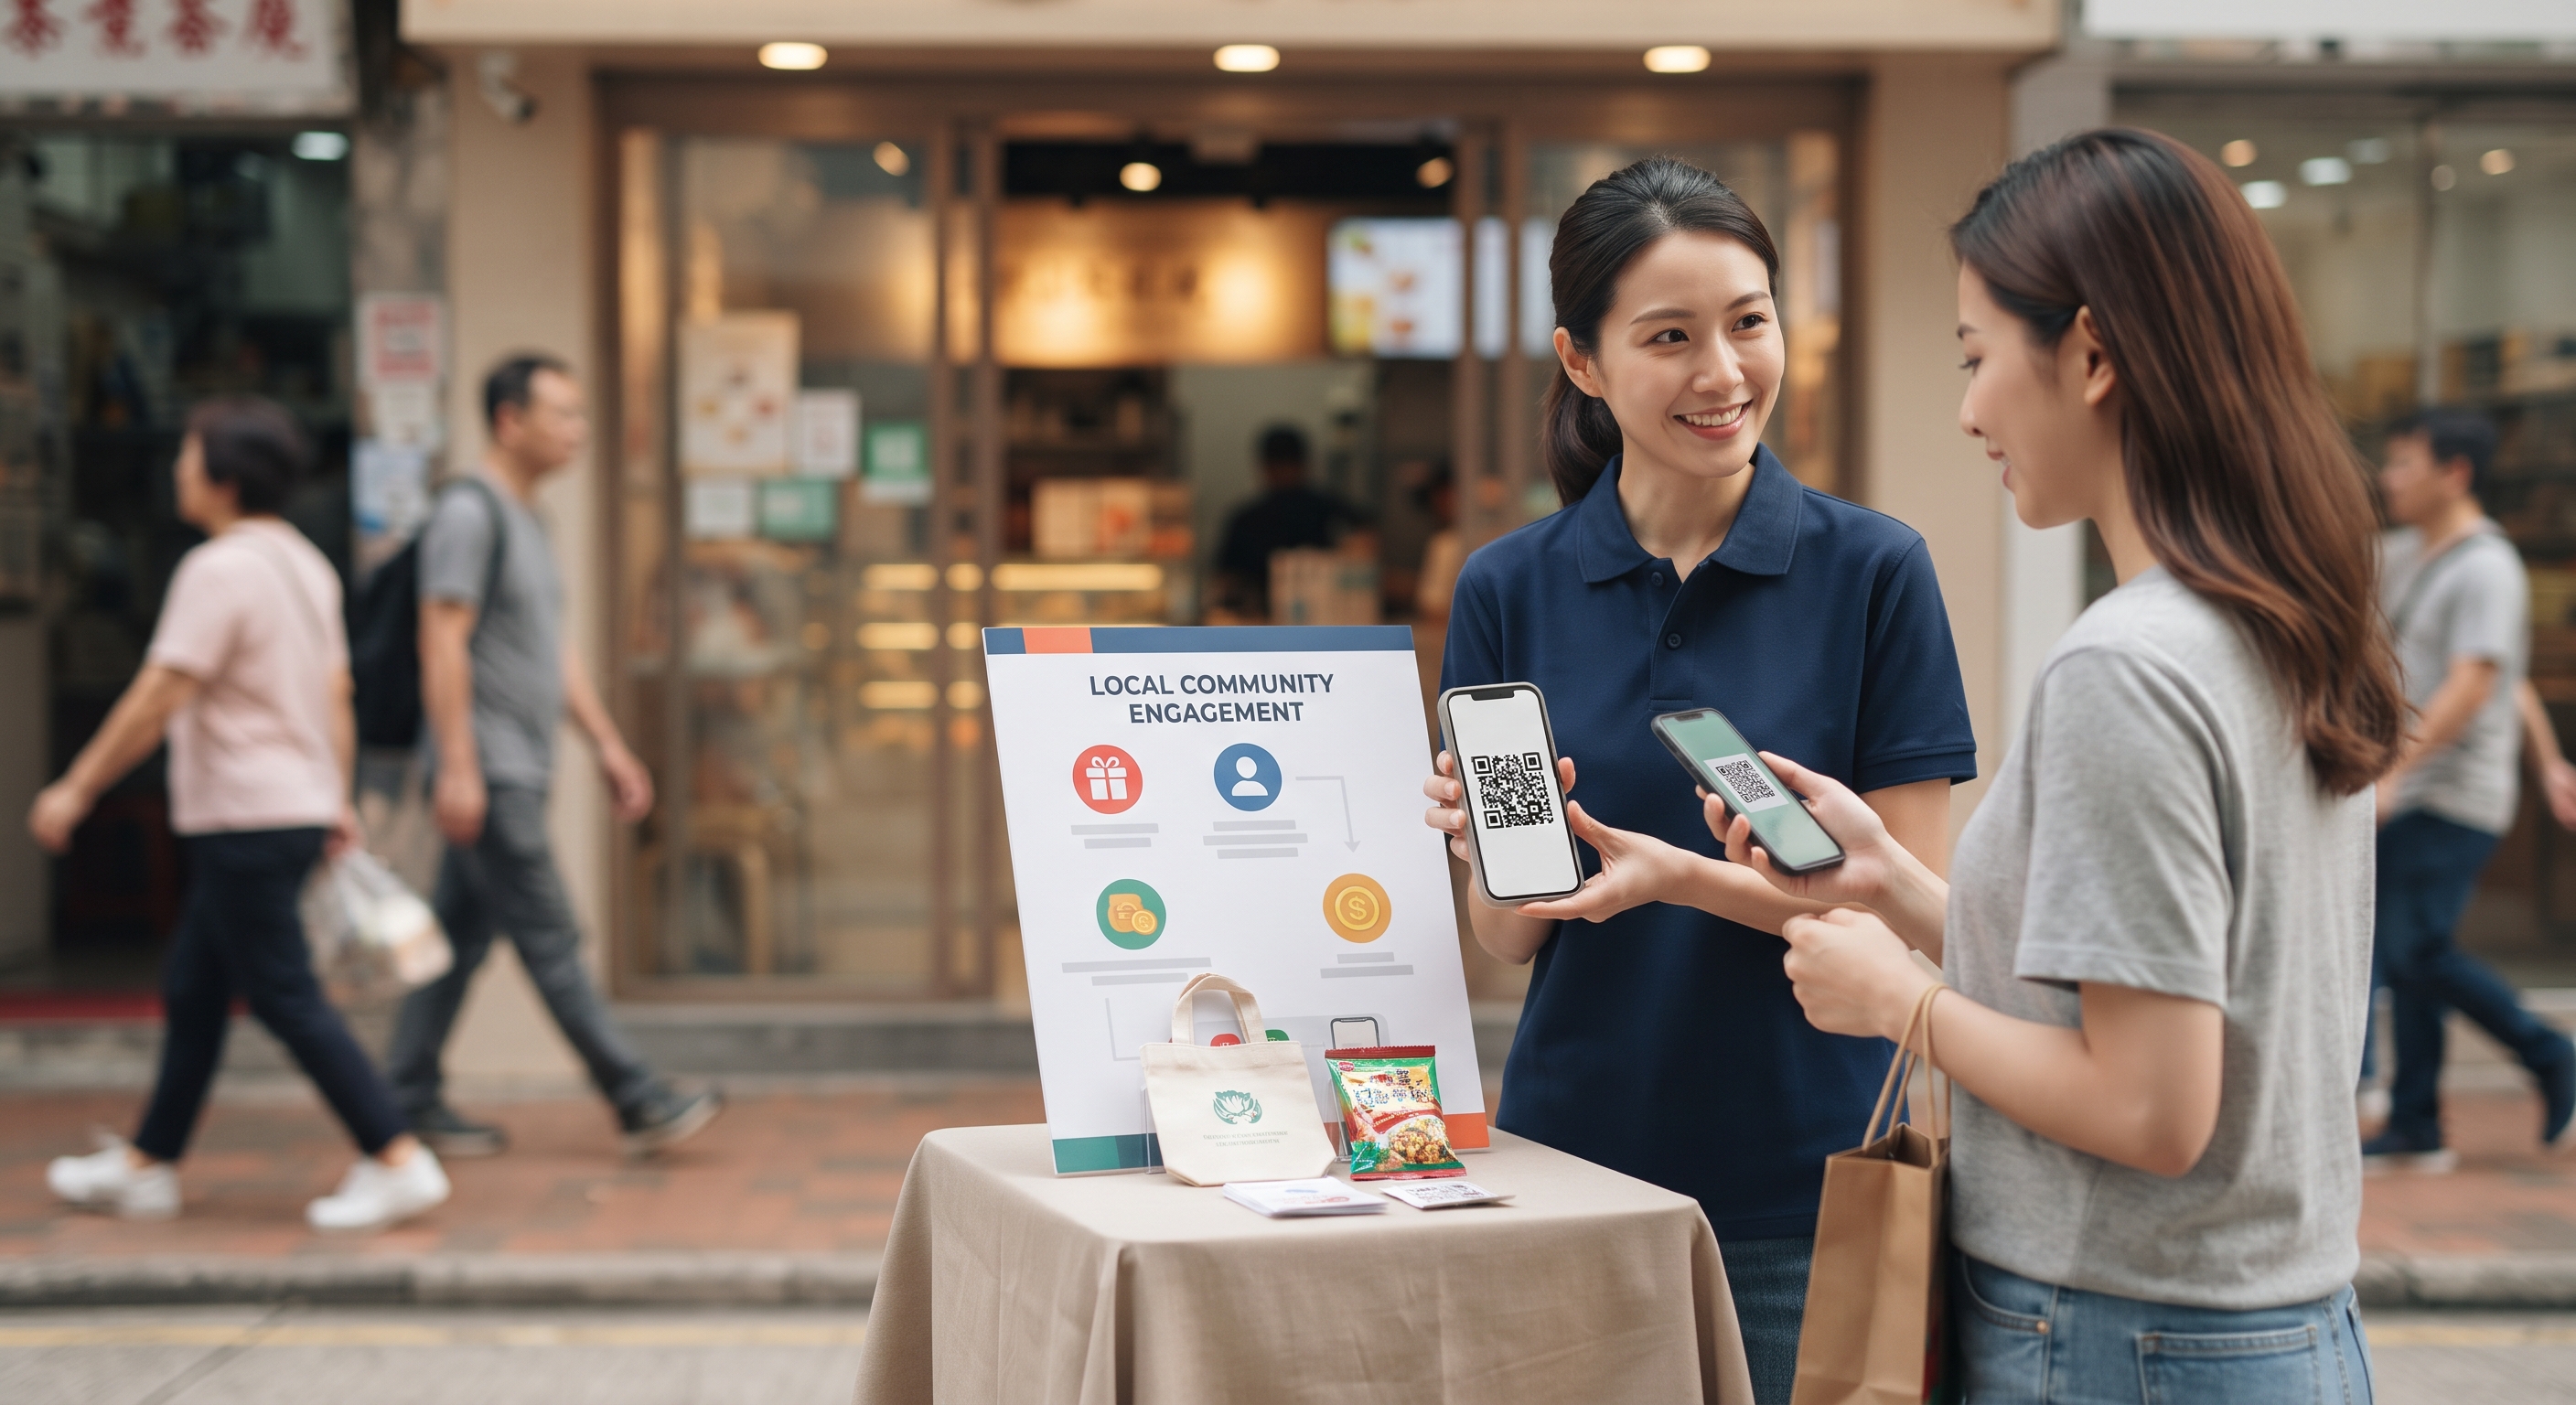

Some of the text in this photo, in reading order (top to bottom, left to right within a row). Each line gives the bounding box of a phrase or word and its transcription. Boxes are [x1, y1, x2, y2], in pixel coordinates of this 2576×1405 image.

[1089, 673, 1334, 696] LOCAL COMMUNITY
[1129, 702, 1304, 724] ENGAGEMENT
